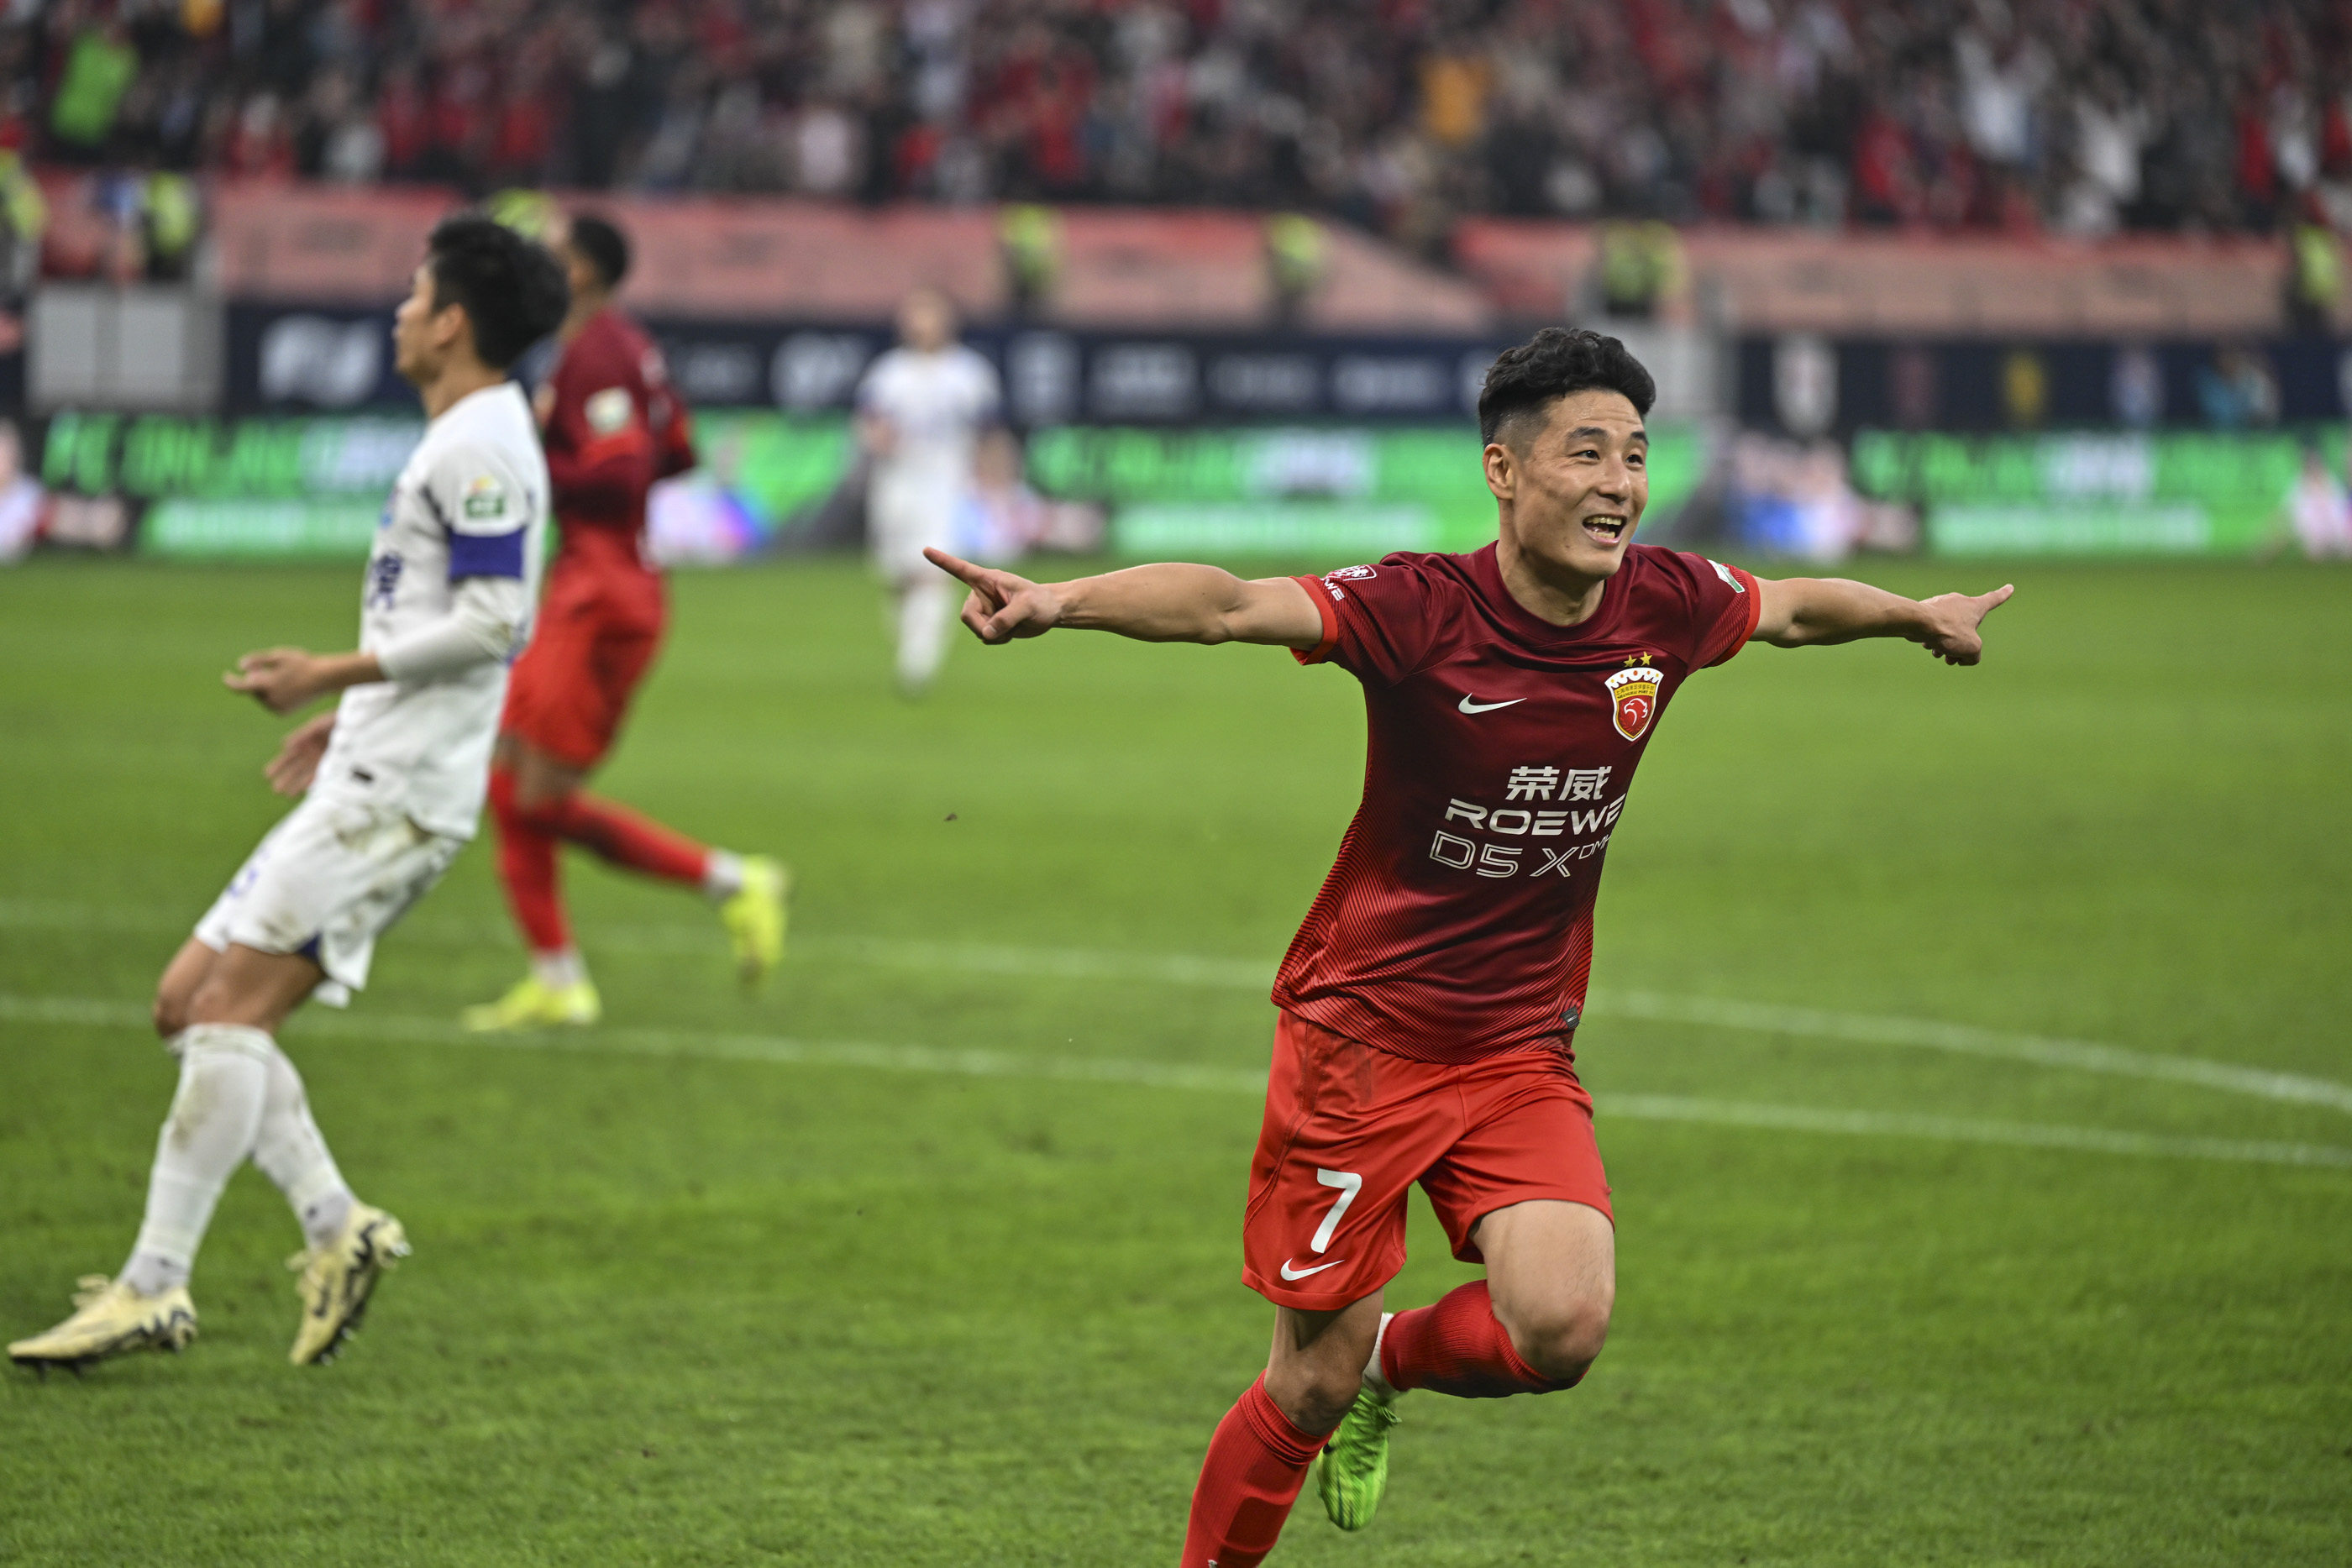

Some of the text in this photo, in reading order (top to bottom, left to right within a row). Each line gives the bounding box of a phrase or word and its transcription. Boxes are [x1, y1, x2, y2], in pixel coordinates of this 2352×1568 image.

[1320, 578, 1345, 600] WE
[1505, 766, 1612, 801] 荣威
[1444, 793, 1626, 836] ROEWE
[1429, 830, 1523, 878] D5
[1310, 1167, 1362, 1254] 7
